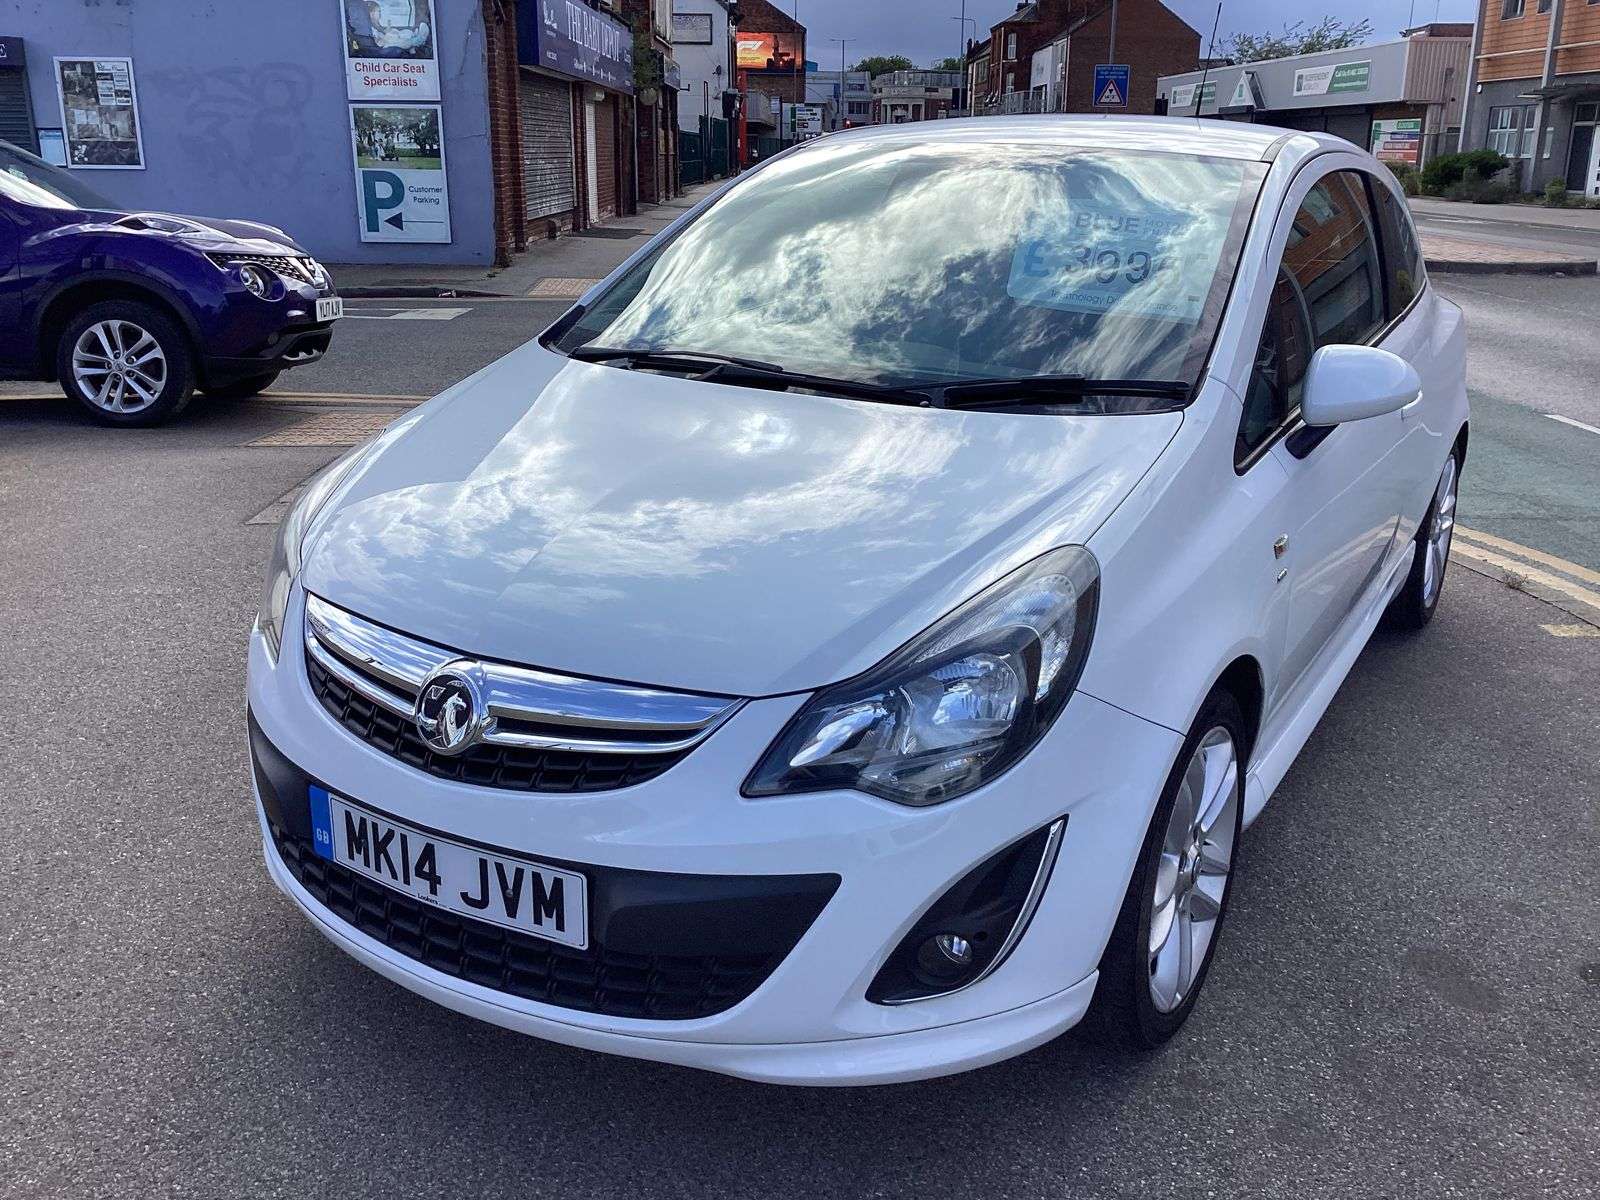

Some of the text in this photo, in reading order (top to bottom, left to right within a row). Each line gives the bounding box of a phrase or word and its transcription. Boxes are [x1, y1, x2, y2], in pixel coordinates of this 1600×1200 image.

[565, 0, 583, 45] THE
[583, 11, 601, 54] BABY
[601, 22, 620, 62] DEPOT
[354, 62, 426, 74] Child Car Seat
[363, 75, 418, 88] Specialists
[408, 185, 443, 194] Customer
[361, 170, 405, 233] P
[413, 195, 440, 205] Parking
[316, 827, 329, 844] GB
[344, 809, 566, 932] MK14 JVM
